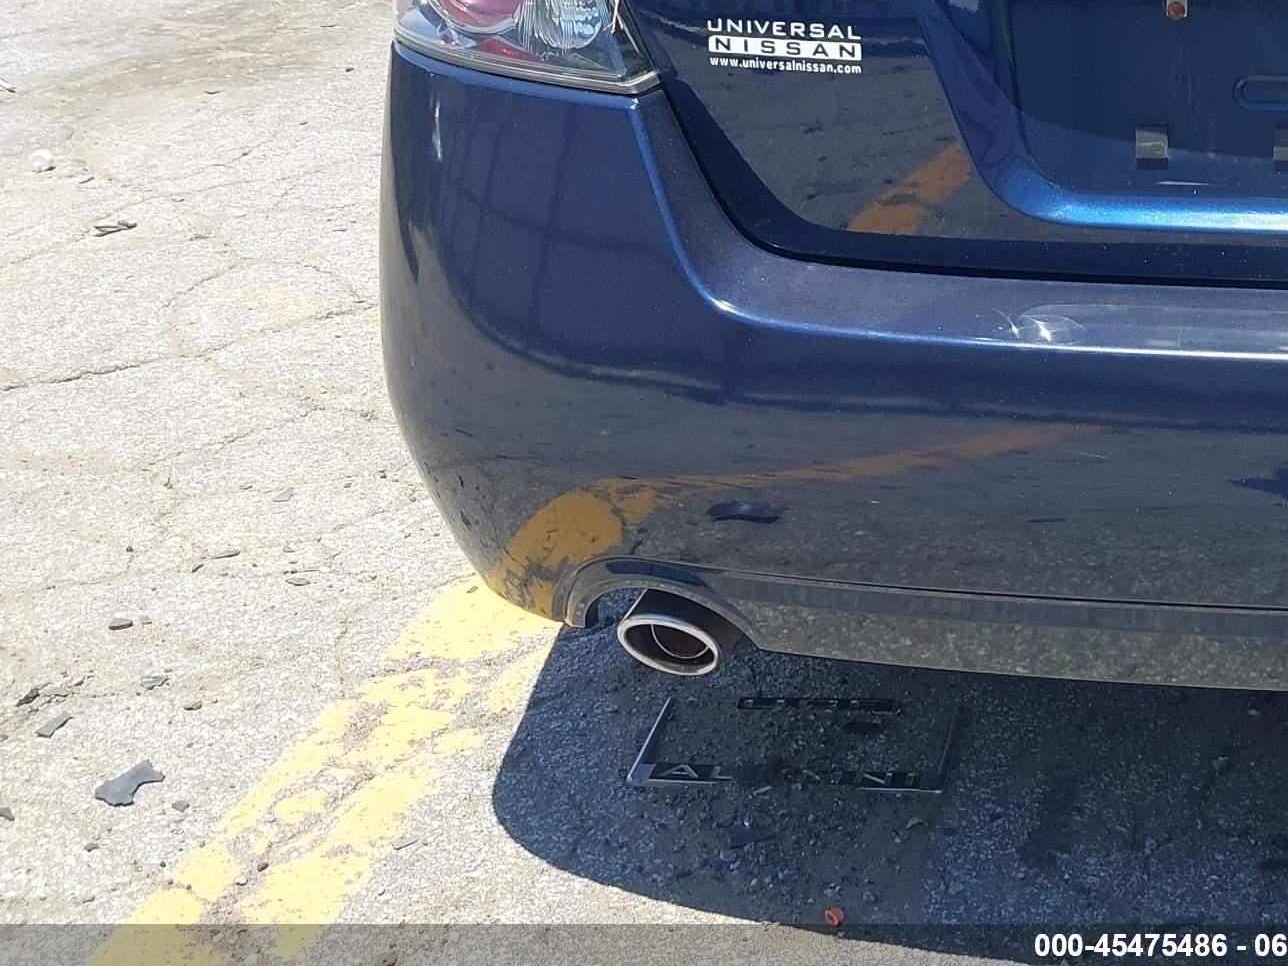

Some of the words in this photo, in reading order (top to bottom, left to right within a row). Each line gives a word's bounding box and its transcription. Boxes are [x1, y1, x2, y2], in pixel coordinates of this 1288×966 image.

[707, 18, 862, 40] UNIVERSAL
[715, 37, 856, 58] NISSAN
[709, 56, 862, 75] www.universalnissan.com
